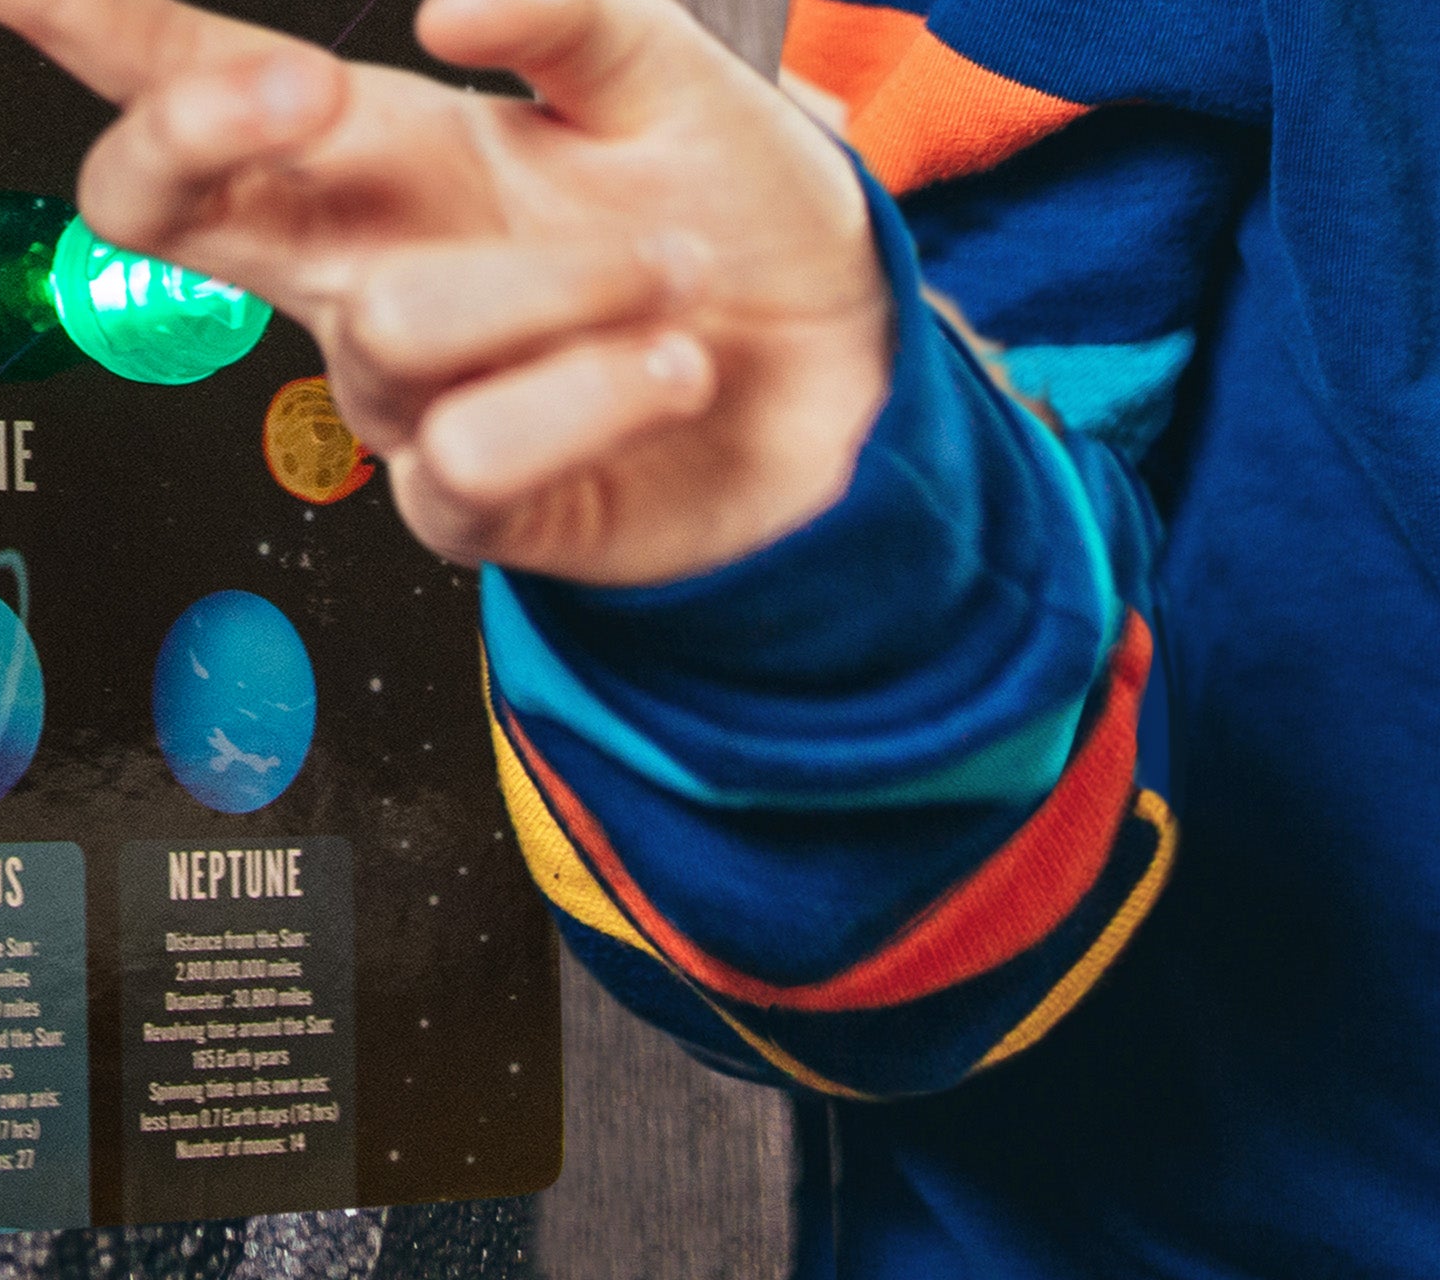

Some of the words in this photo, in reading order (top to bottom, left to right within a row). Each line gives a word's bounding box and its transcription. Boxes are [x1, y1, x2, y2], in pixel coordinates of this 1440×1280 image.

[169, 848, 304, 900] NEPTUNE
[268, 958, 302, 977] miles
[216, 1048, 251, 1068] Earth
[253, 1050, 289, 1070] years
[140, 1113, 167, 1131] less
[169, 1112, 198, 1130] than
[221, 1107, 256, 1127] Earth
[258, 1107, 288, 1127] days
[312, 1102, 339, 1121] hrs)
[11, 1119, 40, 1139] hrs)
